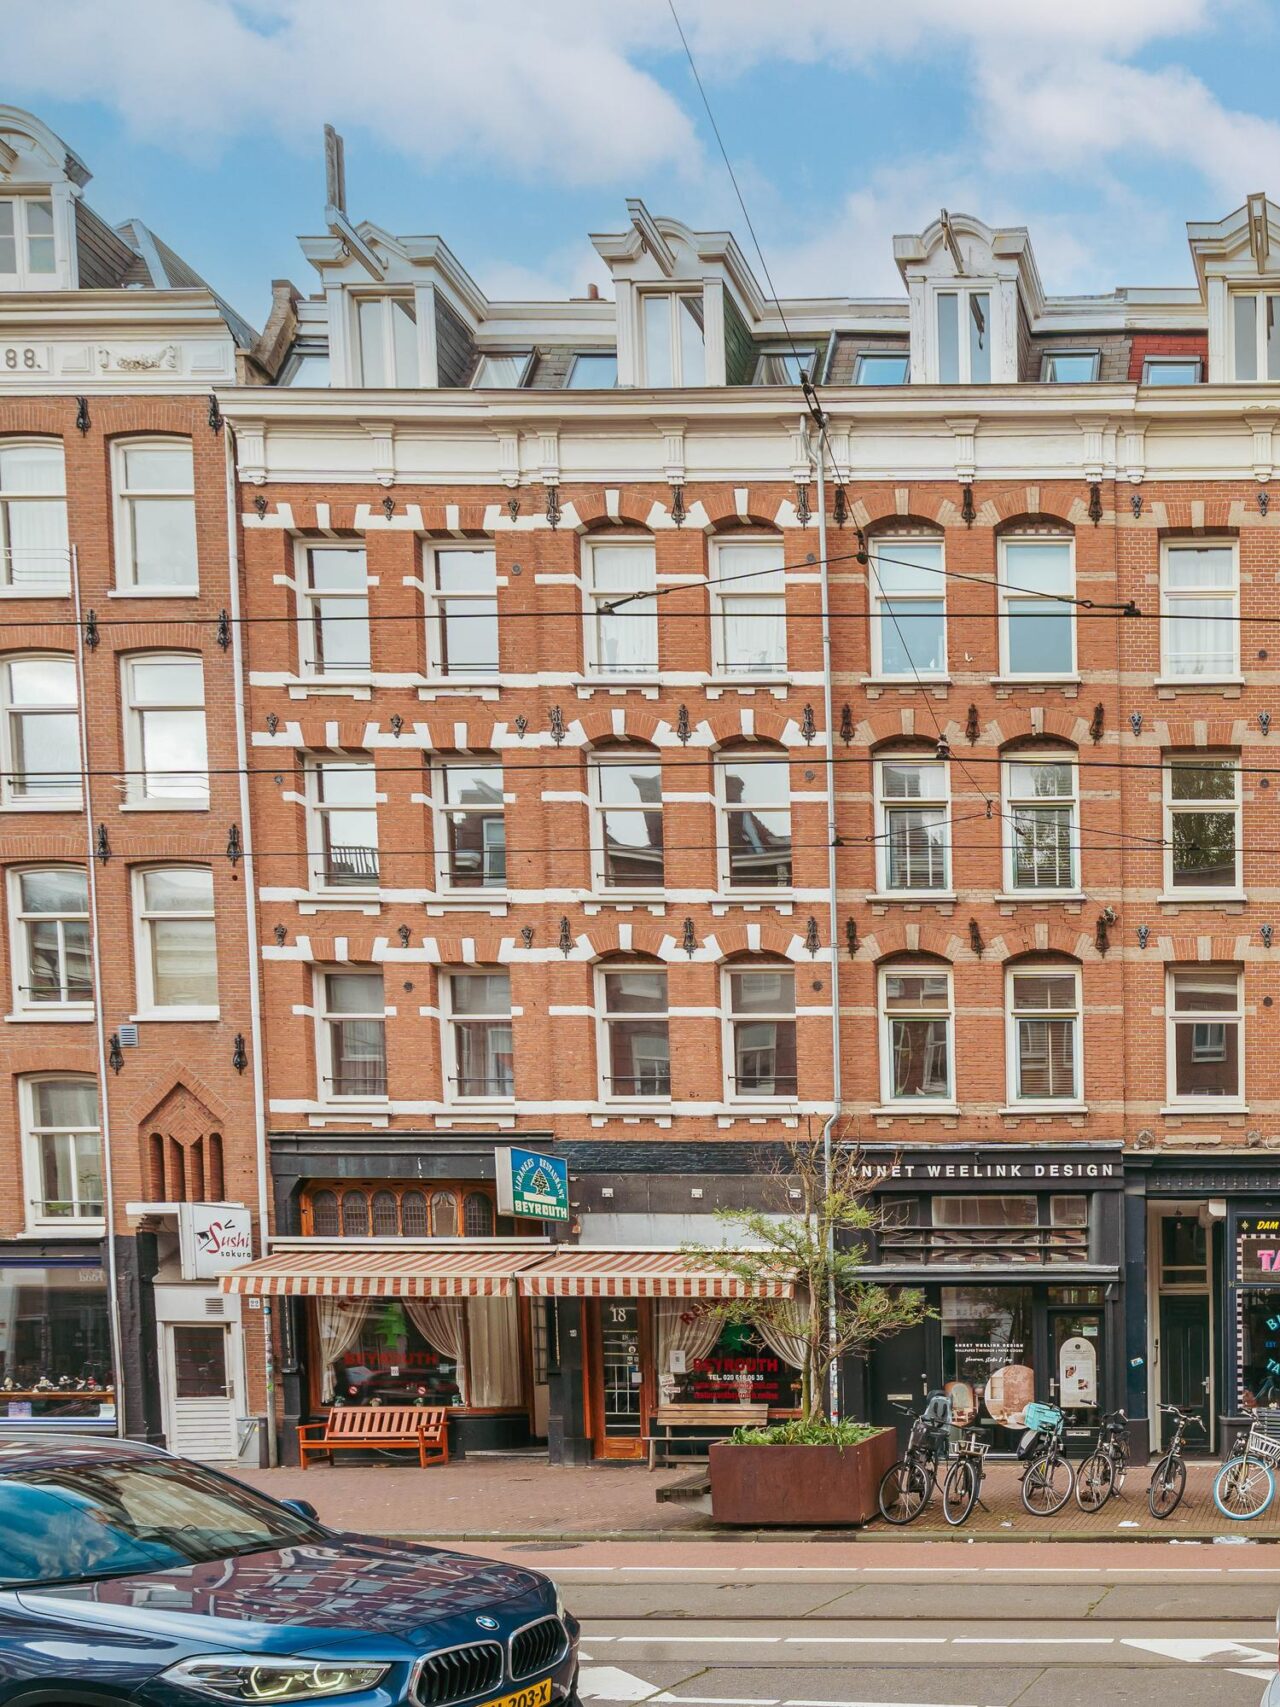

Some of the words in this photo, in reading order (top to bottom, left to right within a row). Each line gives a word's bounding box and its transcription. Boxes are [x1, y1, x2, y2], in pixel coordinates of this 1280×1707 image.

[927, 1165, 1022, 1177] WEELINK
[1034, 1164, 1114, 1177] DESIGN
[514, 1200, 567, 1219] BEYROUTH
[1256, 1220, 1279, 1230] DAM
[206, 1221, 250, 1254] Sushi
[221, 1249, 252, 1258] sakura
[611, 1308, 627, 1322] 18
[693, 1357, 779, 1372] BEYROUTH
